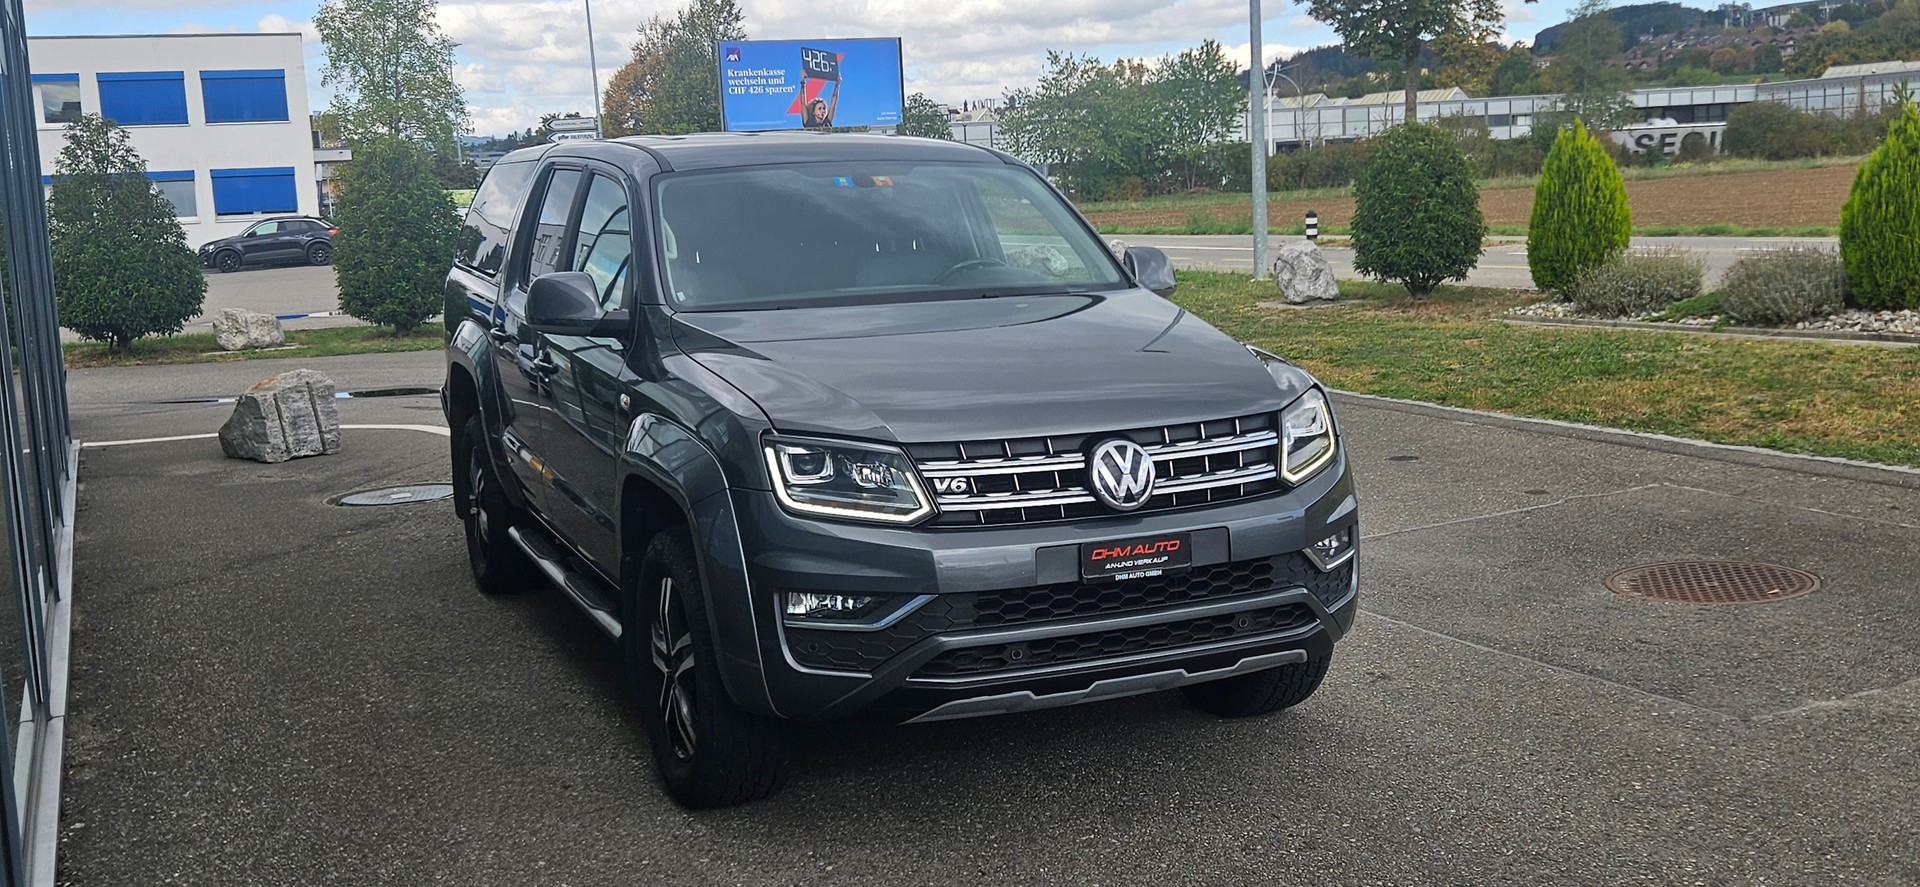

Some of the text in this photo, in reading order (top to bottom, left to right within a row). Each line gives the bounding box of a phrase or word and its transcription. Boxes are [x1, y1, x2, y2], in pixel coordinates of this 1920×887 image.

[727, 68, 786, 77] Krankenkasse
[728, 76, 785, 86] wechseln und
[728, 86, 747, 95] CHF
[748, 86, 764, 94] 426
[933, 477, 967, 493] V6
[1091, 540, 1180, 560] DHM AUTO
[1115, 573, 1129, 581] DHM
[1129, 571, 1145, 579] AUTO
